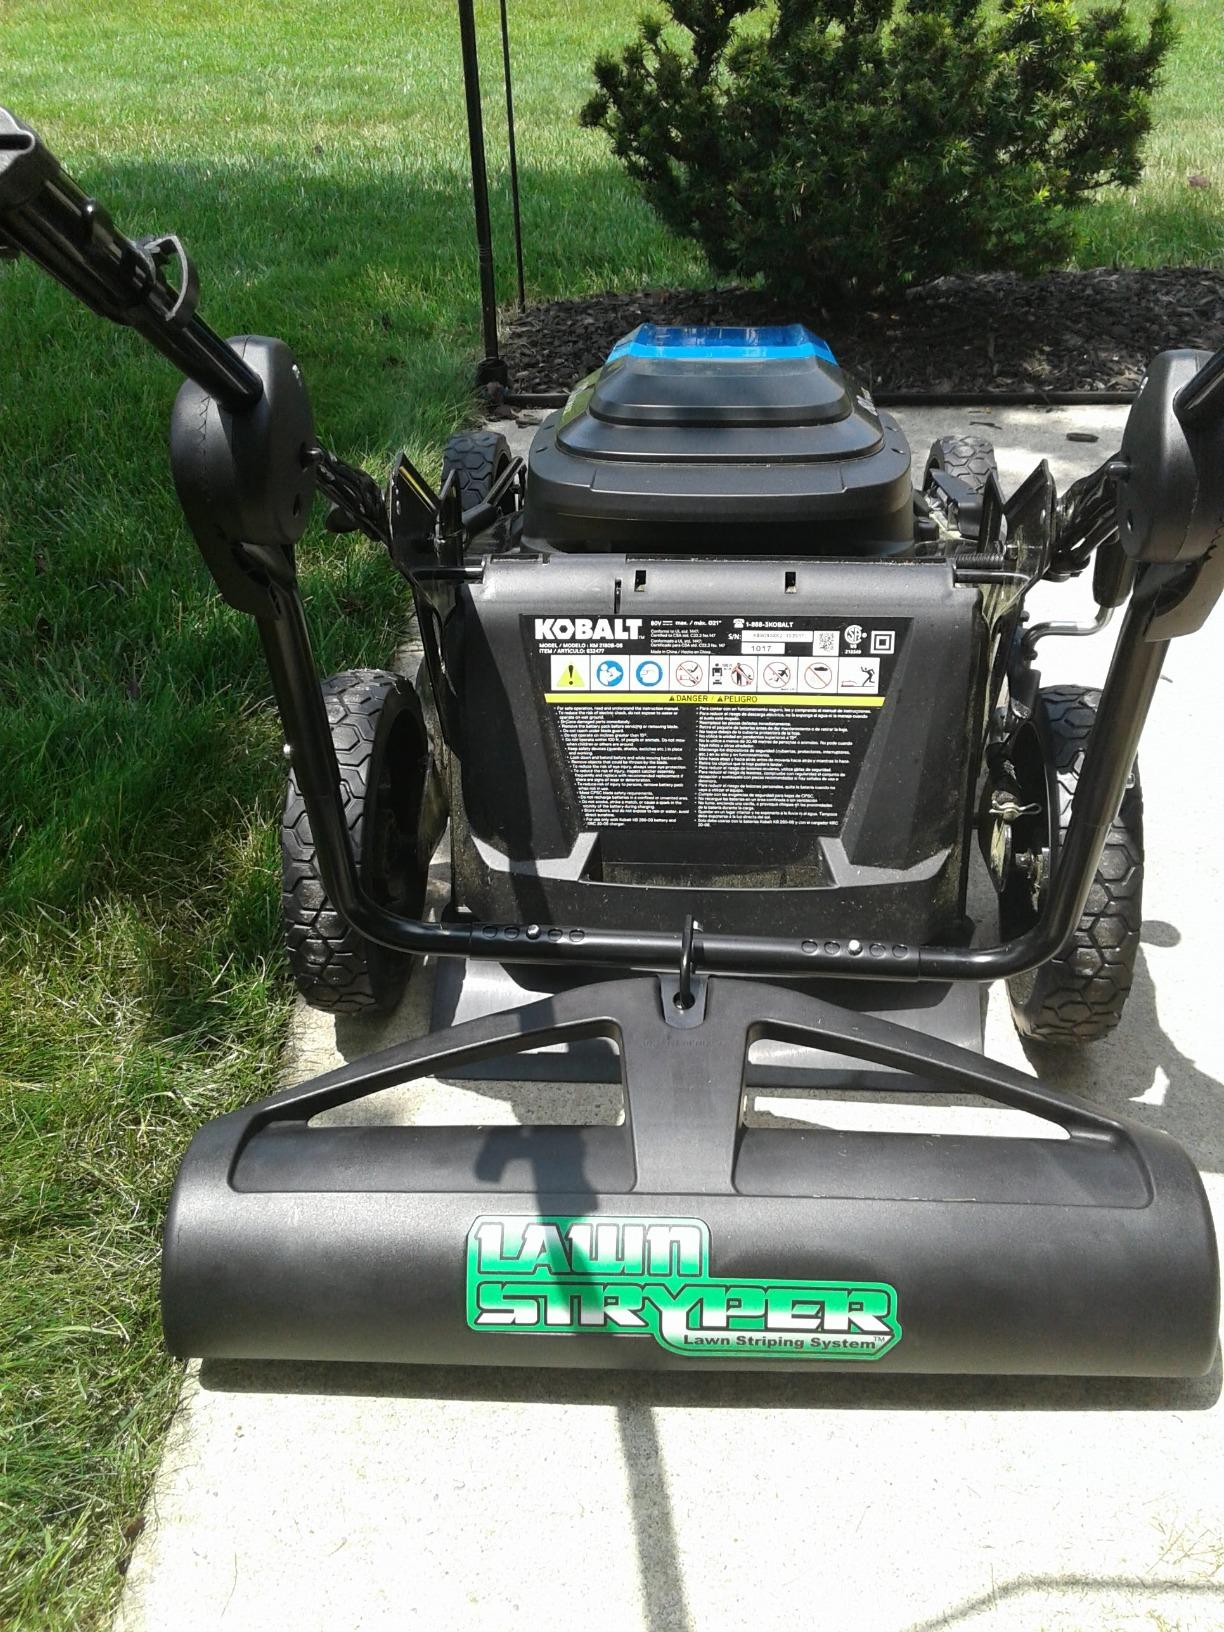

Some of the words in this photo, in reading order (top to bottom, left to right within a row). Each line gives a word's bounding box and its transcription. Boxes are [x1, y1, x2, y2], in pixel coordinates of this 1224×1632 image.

[535, 618, 642, 640] KOBALT
[475, 1281, 894, 1333] STRYPER
[684, 1334, 732, 1348] Lawn
[736, 1335, 805, 1351] Striping
[810, 1336, 876, 1351] System
